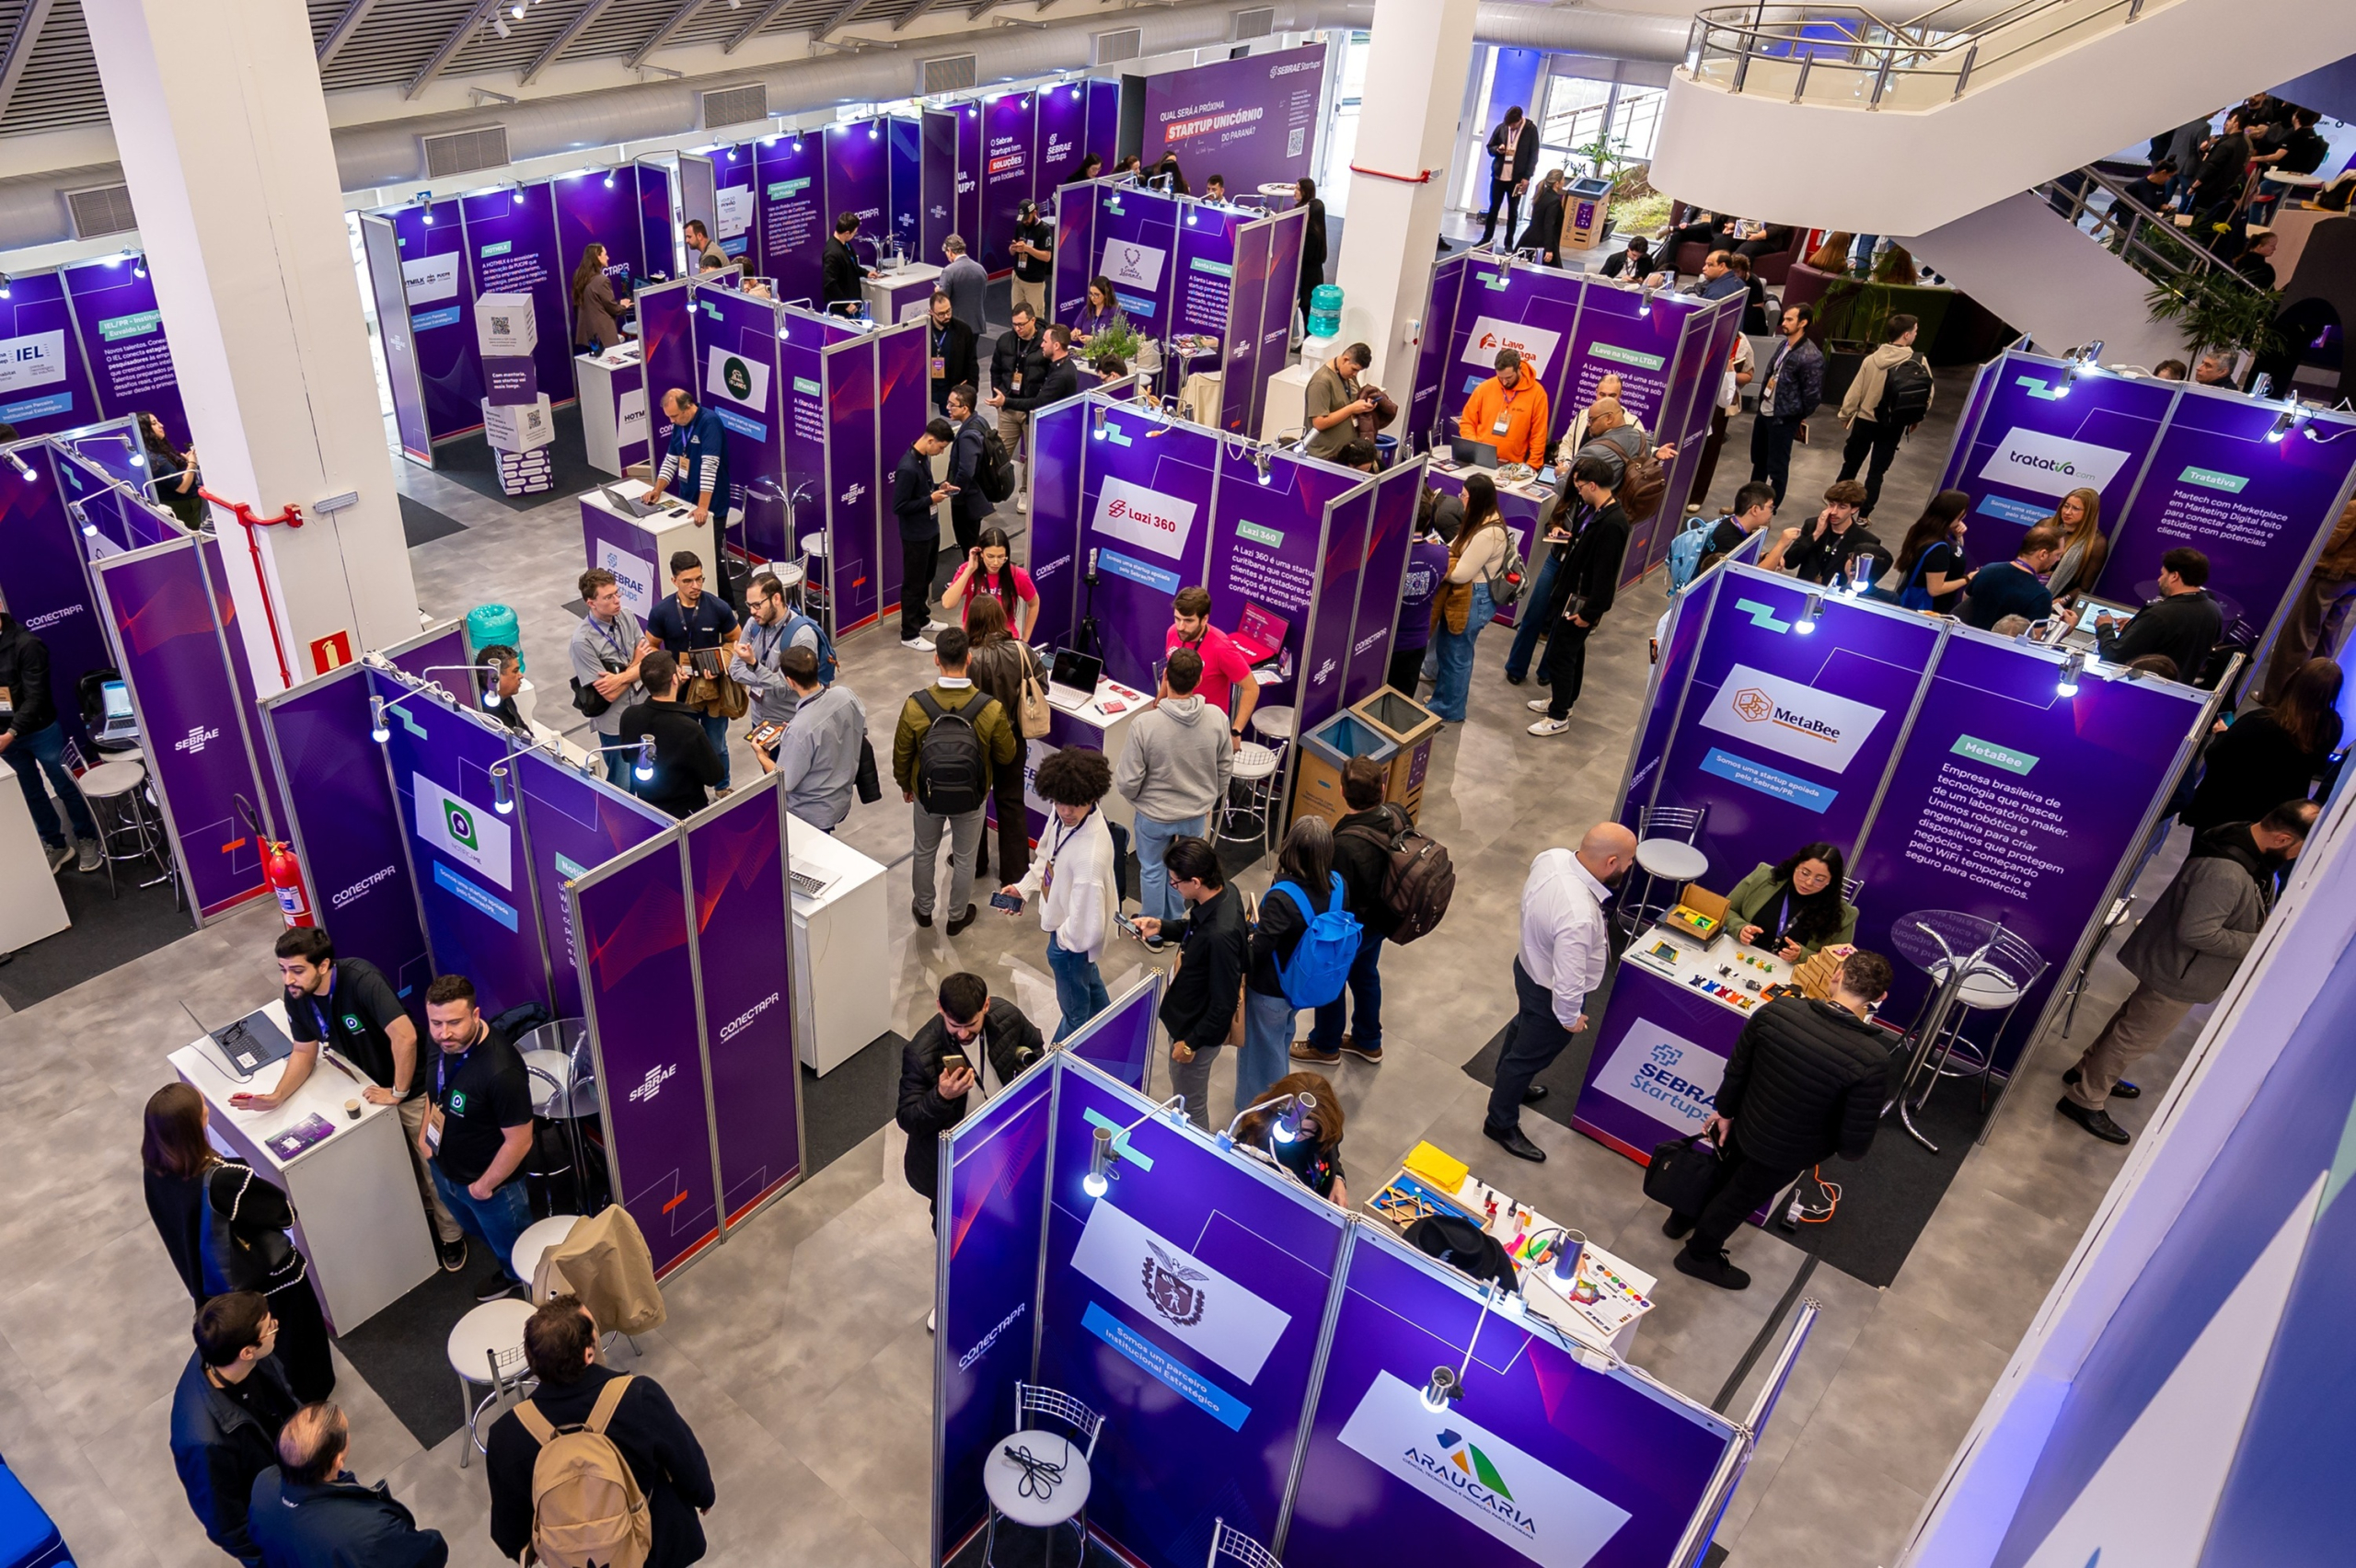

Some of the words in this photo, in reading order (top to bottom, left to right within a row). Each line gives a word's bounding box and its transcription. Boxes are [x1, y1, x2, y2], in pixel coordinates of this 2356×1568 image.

[1277, 63, 1300, 75] SEBRAE
[1161, 111, 1176, 121] QUAL
[1177, 108, 1194, 119] SERÁ
[1199, 100, 1225, 113] PRÓXIMA
[1169, 121, 1212, 139] STARTUP
[1214, 107, 1263, 129] UNICÓRNIO
[996, 136, 1012, 145] Sebrae
[1221, 133, 1230, 142] DO
[1230, 127, 1256, 140] PARANÁ?
[990, 147, 1011, 156] Startups
[1046, 153, 1067, 163] Startups
[1047, 143, 1072, 155] SEBRAE
[990, 174, 1000, 184] para
[1001, 171, 1014, 180] todas
[1014, 168, 1025, 177] elas.
[992, 156, 1022, 170] SOLUÇÕES
[109, 327, 136, 336] Euvaldo
[1502, 338, 1524, 350] Lavo
[17, 345, 43, 362] IEL
[1519, 352, 1536, 361] aga
[1595, 346, 1611, 355] Lavo
[1622, 352, 1638, 362] Vaga
[1639, 356, 1657, 365] LTDA
[2190, 471, 2235, 487] Tratativa
[841, 486, 865, 502] SEBRAE
[2173, 490, 2209, 503] Martech
[2211, 500, 2231, 508] com
[2232, 502, 2287, 521] Marketplace
[1129, 508, 1150, 525] Lazi
[1154, 516, 1175, 532] 360
[2164, 509, 2184, 518] para
[2185, 513, 2224, 526] conectar
[2225, 523, 2265, 536] agências
[2184, 502, 2228, 519] Marketing
[2229, 512, 2259, 525] Digital
[2260, 519, 2281, 529] feito
[1242, 525, 1258, 536] Lazi
[1260, 531, 1276, 541] 360
[2156, 526, 2190, 539] clientes.
[2161, 518, 2197, 531] estúdios
[2199, 526, 2218, 536] com
[2219, 532, 2266, 547] potenciais
[1035, 555, 1070, 576] CONECTAPR
[1231, 555, 1265, 571] curitibana
[1266, 567, 1279, 575] que
[1280, 571, 1309, 585] conecta
[1240, 547, 1253, 557] Lazi
[1254, 551, 1268, 561] 360
[1275, 559, 1290, 569] uma
[1230, 565, 1257, 578] clientes
[1264, 576, 1304, 594] prestadores
[1230, 574, 1257, 587] serviços
[1269, 585, 1288, 598] forma
[1229, 583, 1259, 597] confiável
[1265, 596, 1298, 612] acessível.
[26, 604, 84, 628] CONECTAPR
[1773, 707, 1840, 738] MetaBee
[175, 727, 219, 752] SEBRAE
[1965, 742, 2022, 767] MetaBee
[1716, 755, 1740, 768] Somos
[1742, 766, 1758, 775] uma
[1760, 772, 1787, 785] startup
[1788, 782, 1819, 796] apoiada
[1942, 762, 1990, 785] Empresa
[1992, 778, 2042, 802] brasileira
[2045, 798, 2061, 808] de
[1932, 786, 1946, 796] de
[1948, 791, 1967, 802] um
[1969, 797, 2029, 824] laboratório
[2031, 820, 2068, 837] maker.
[1937, 774, 1995, 800] tecnologia
[1997, 795, 2019, 807] que
[2020, 803, 2062, 822] nasceu
[1928, 795, 1969, 815] Unimos
[1970, 812, 2017, 833] robótica
[1923, 808, 1982, 833] engenharia
[1983, 829, 2009, 842] para
[2011, 838, 2038, 851] criar
[1913, 829, 1962, 851] negócios
[1972, 850, 2038, 877] começando
[1918, 818, 1982, 846] dispositivos
[1984, 842, 2005, 853] que
[2006, 849, 2063, 873] protegem
[1905, 850, 1941, 868] seguro
[1942, 864, 1967, 877] para
[1969, 873, 2027, 899] comércios.
[1909, 839, 1933, 852] pelo
[1935, 847, 1959, 861] WiFi
[1960, 857, 2021, 883] temporário
[332, 865, 396, 905] CONECTAPR
[719, 992, 780, 1039] CONECTAPR
[629, 1063, 676, 1101] SEBRAE
[1639, 1063, 1717, 1112] SEBRA
[1630, 1075, 1710, 1123] Startups
[959, 1303, 1025, 1367] CONECTAPR
[1105, 1330, 1161, 1373] Institucional
[1163, 1369, 1218, 1411] Estratégico
[1117, 1327, 1148, 1353] Somos
[1149, 1351, 1164, 1365] um
[1166, 1363, 1207, 1392] parceiro
